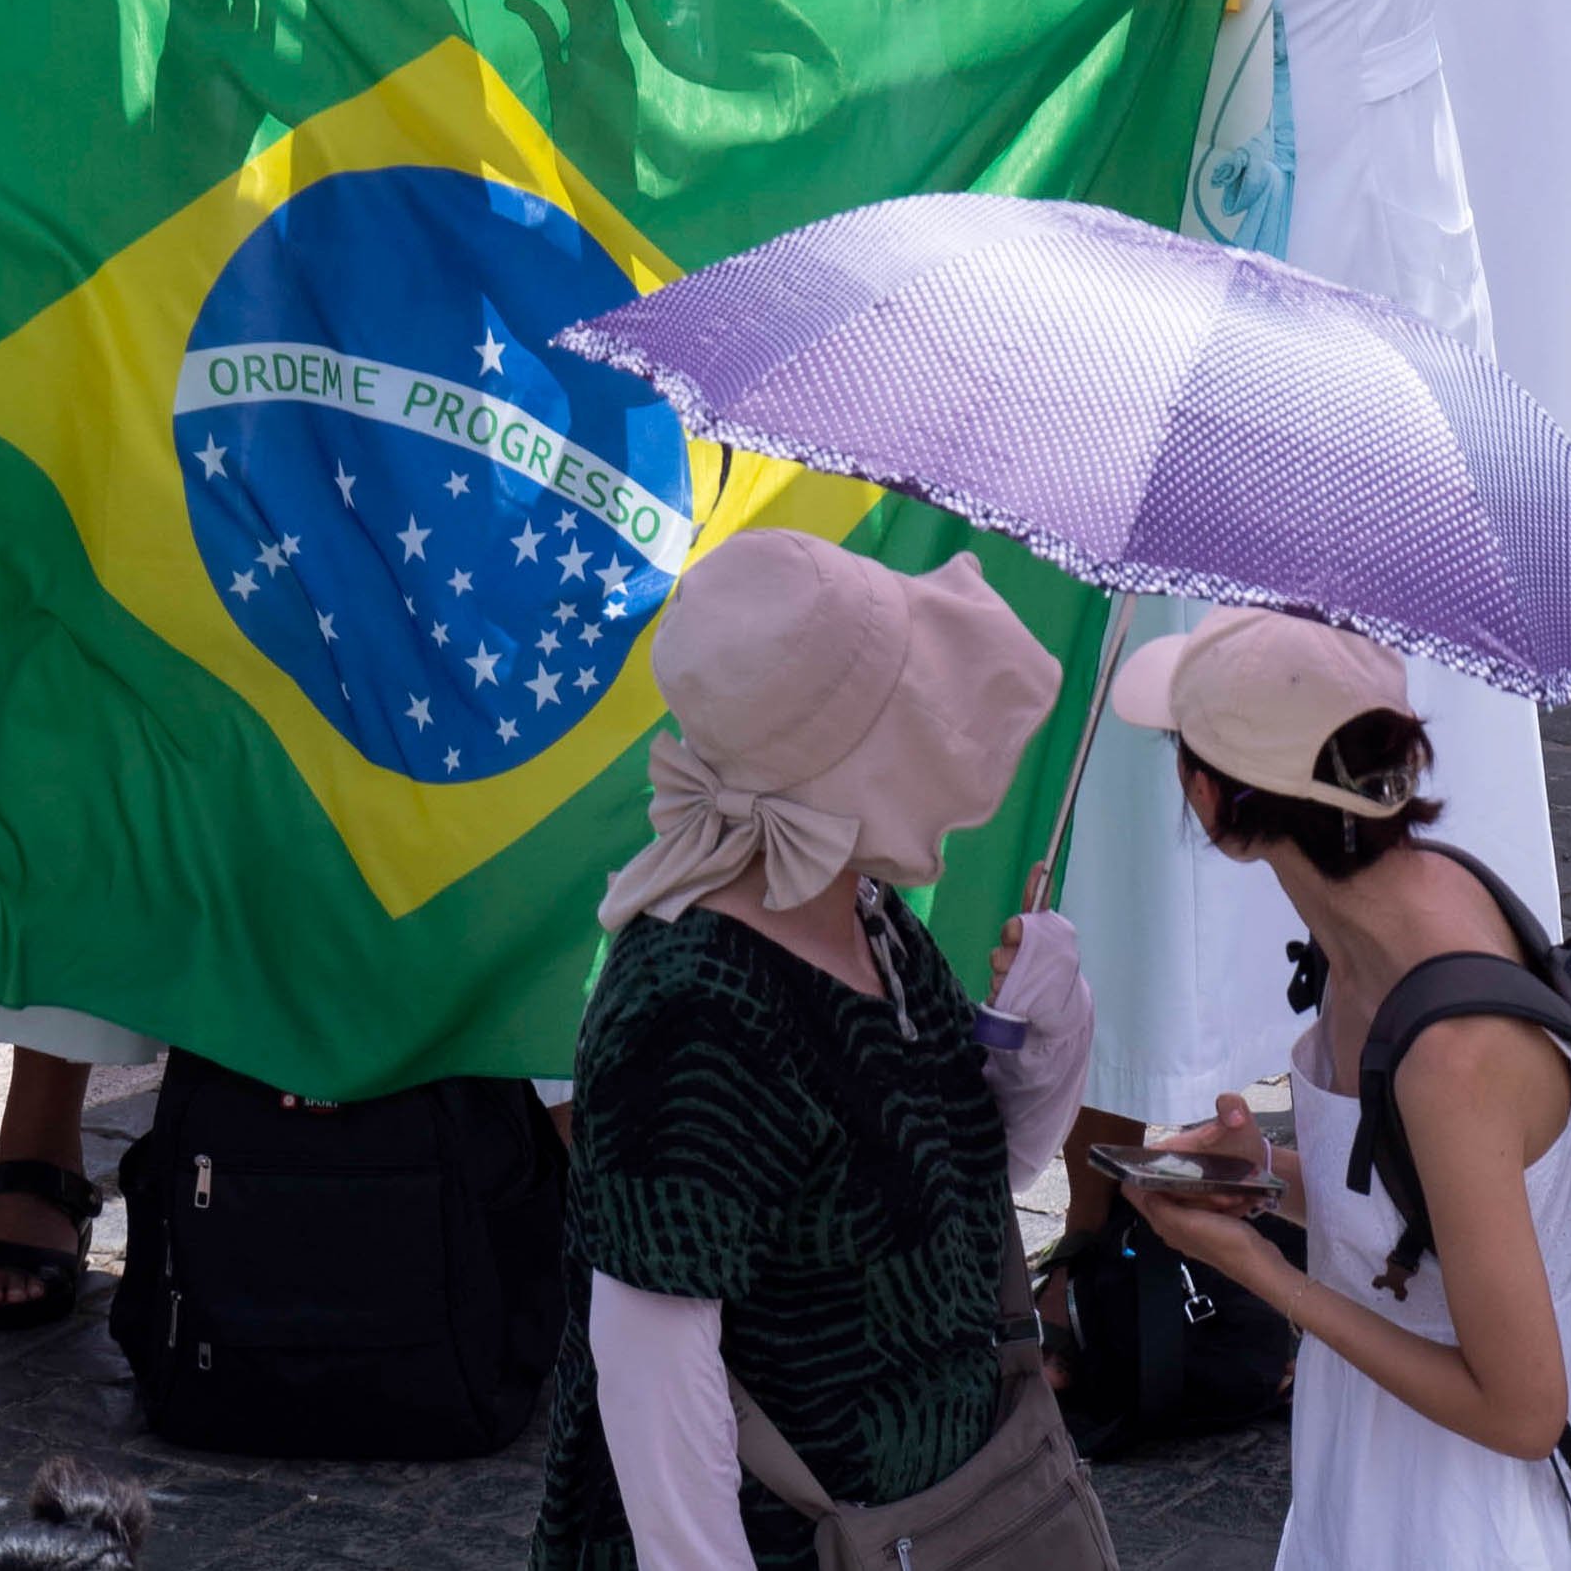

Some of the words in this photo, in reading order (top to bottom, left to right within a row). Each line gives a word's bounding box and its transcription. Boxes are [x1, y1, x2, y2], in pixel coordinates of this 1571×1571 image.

[207, 352, 343, 401] ORDEM
[352, 365, 381, 406] E
[402, 379, 662, 545] PROGRESSO
